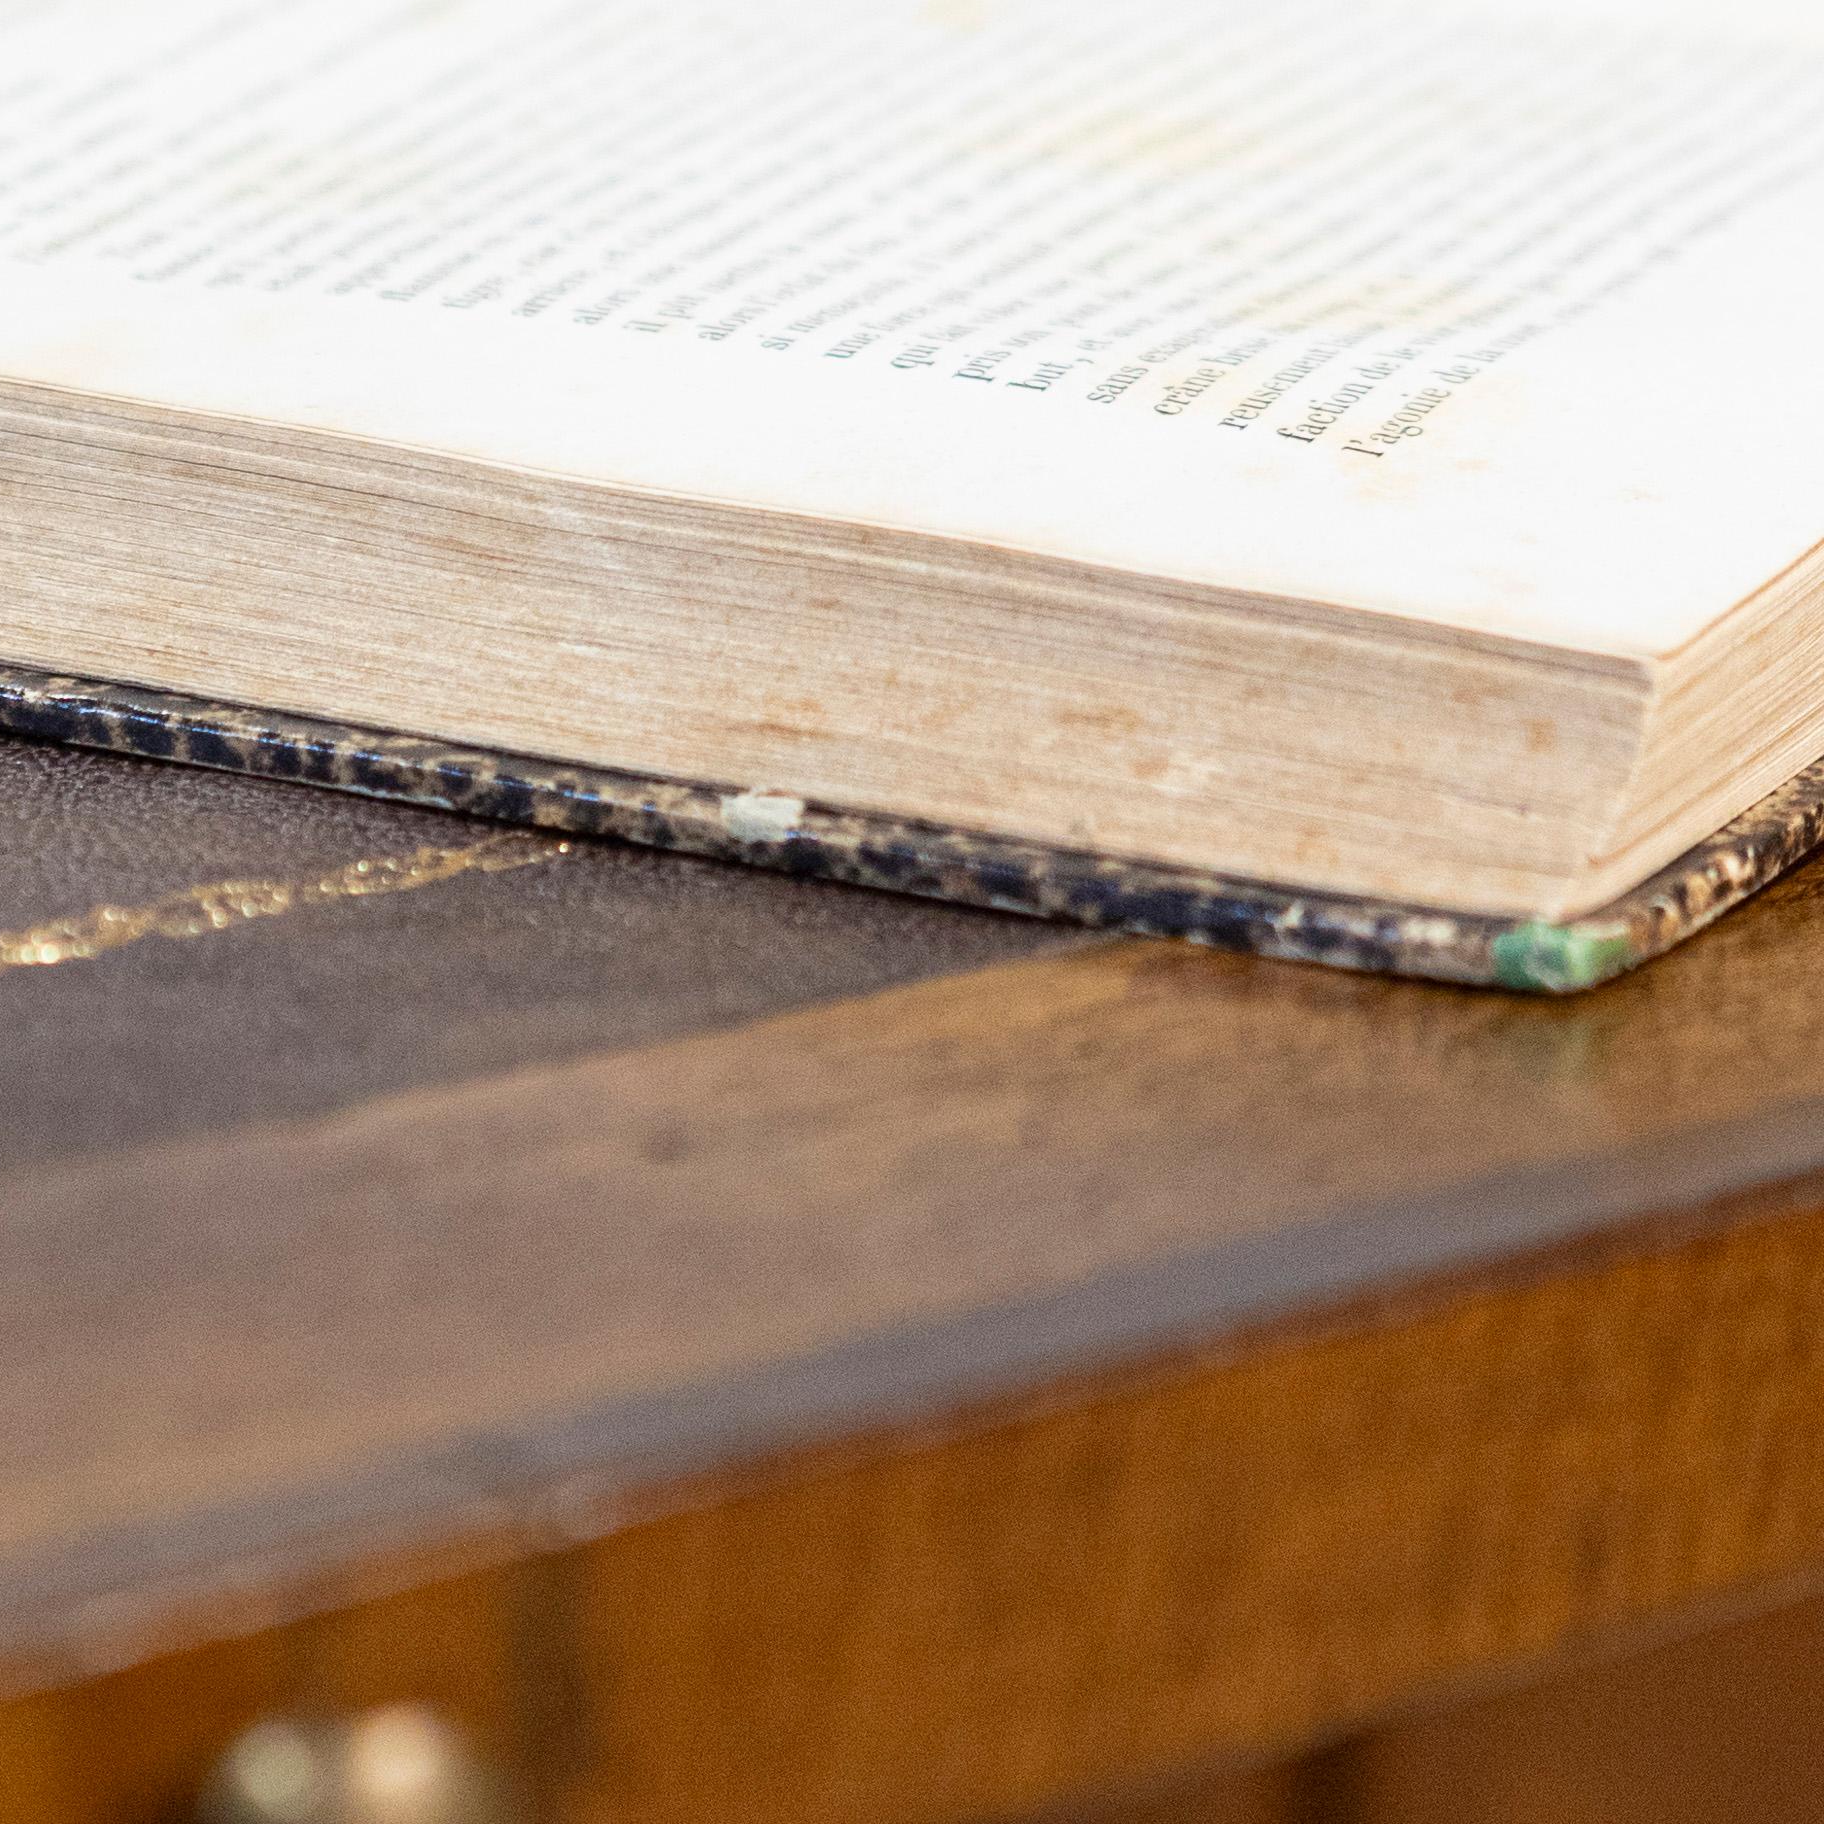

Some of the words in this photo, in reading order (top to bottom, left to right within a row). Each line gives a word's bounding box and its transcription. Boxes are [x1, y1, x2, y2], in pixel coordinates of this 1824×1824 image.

[757, 332, 798, 352] si
[821, 332, 882, 359] une
[890, 342, 942, 370] qui
[951, 353, 1013, 384] pris
[1428, 365, 1482, 386] de
[1085, 364, 1150, 405] sans
[1153, 367, 1228, 417] crâne
[1217, 346, 1342, 432] reusement
[1276, 381, 1375, 444] faction
[1351, 361, 1402, 382] de
